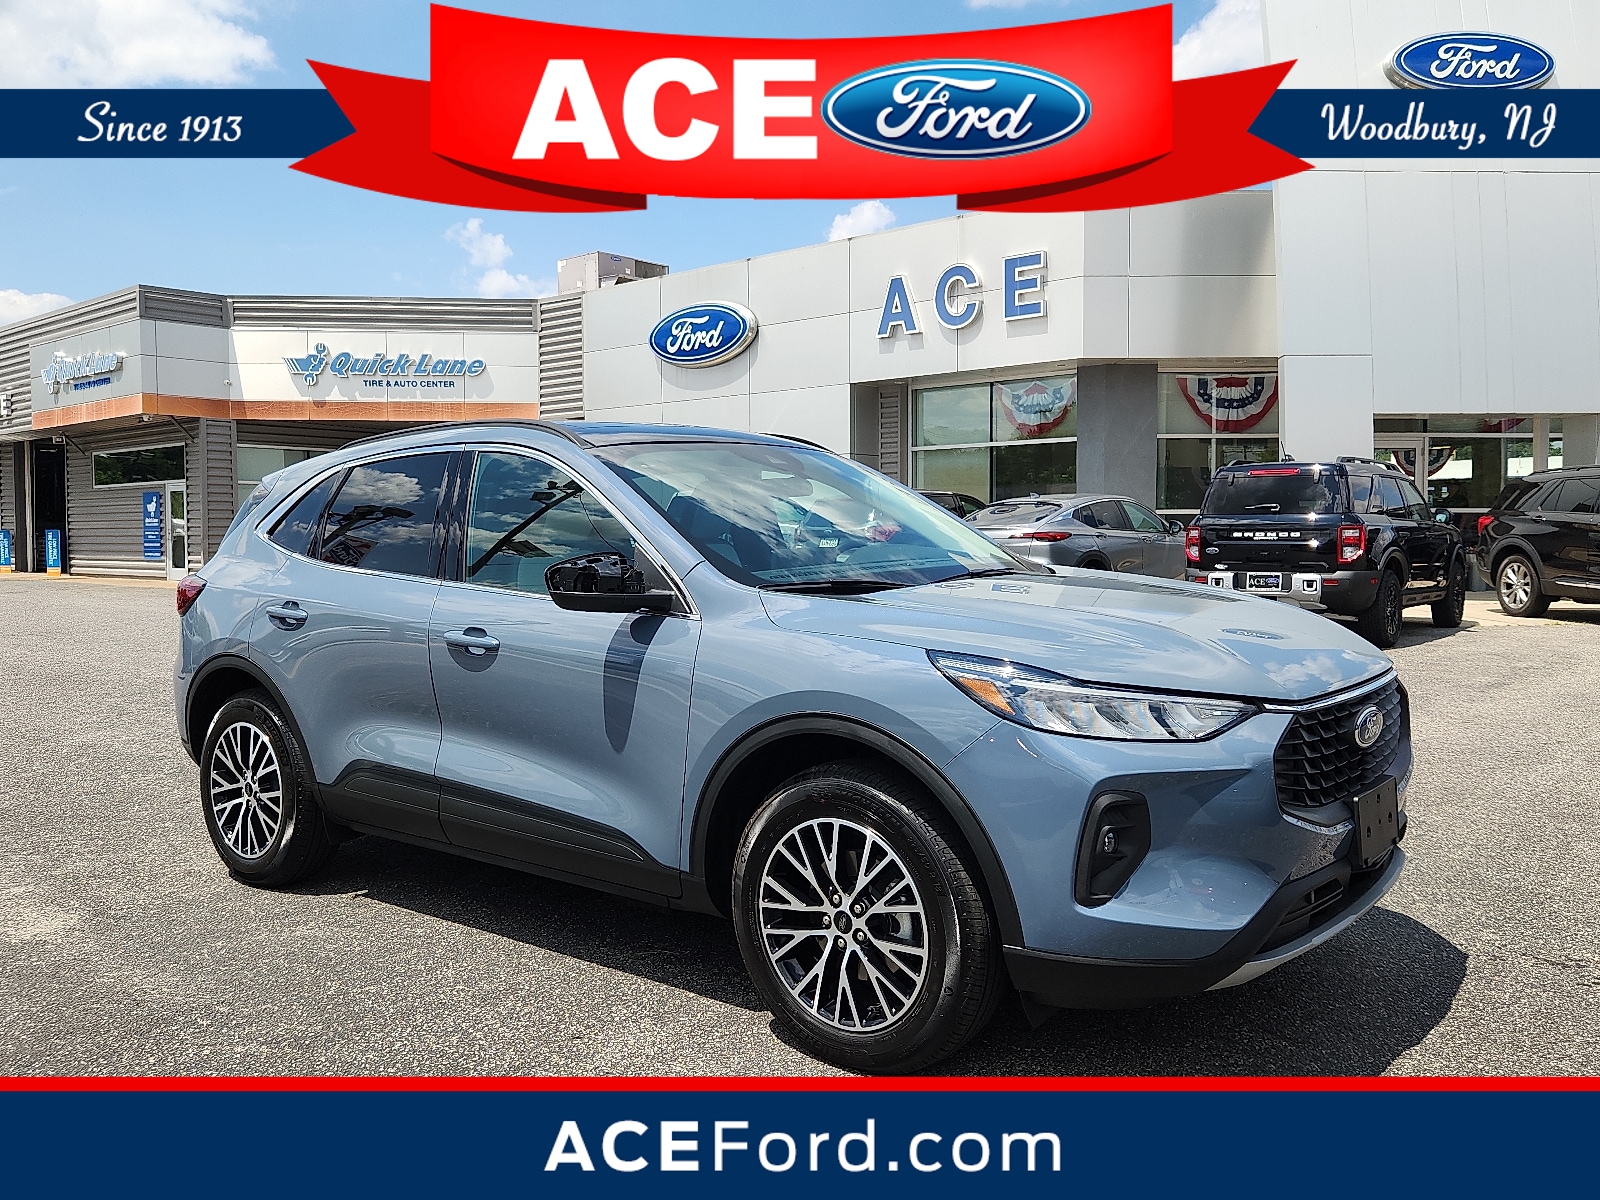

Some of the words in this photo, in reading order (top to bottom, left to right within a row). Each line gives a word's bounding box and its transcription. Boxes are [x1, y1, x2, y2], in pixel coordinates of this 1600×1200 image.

[1430, 43, 1521, 79] Ford
[875, 250, 1048, 339] ACE
[666, 315, 725, 354] Ford
[329, 351, 411, 378] Quick
[413, 353, 486, 378] Lane
[363, 379, 384, 388] TIRE
[386, 380, 392, 388] &
[393, 380, 418, 388] AUTO
[419, 380, 455, 388] CENTER
[1249, 577, 1266, 586] ACE
